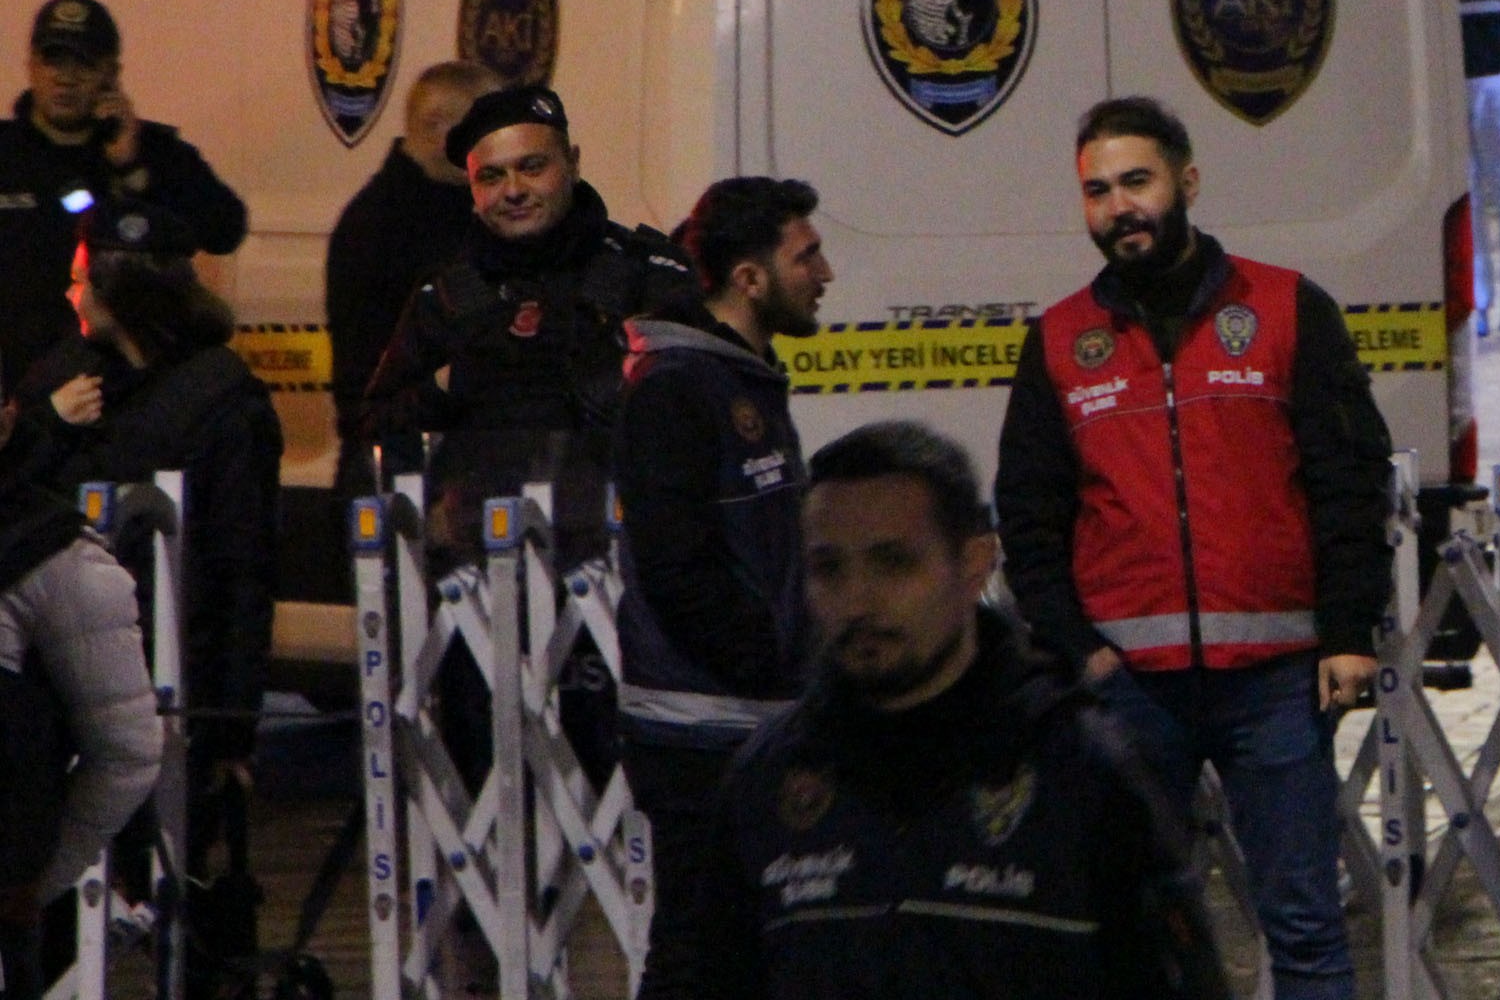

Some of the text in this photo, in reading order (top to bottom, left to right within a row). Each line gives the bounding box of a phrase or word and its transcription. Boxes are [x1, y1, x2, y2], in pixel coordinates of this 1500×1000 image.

[1353, 329, 1423, 351] ELEME
[793, 340, 1020, 373] OLAY YERİ İNCELE
[1207, 366, 1265, 386] POLİS
[365, 650, 392, 882] POLİS
